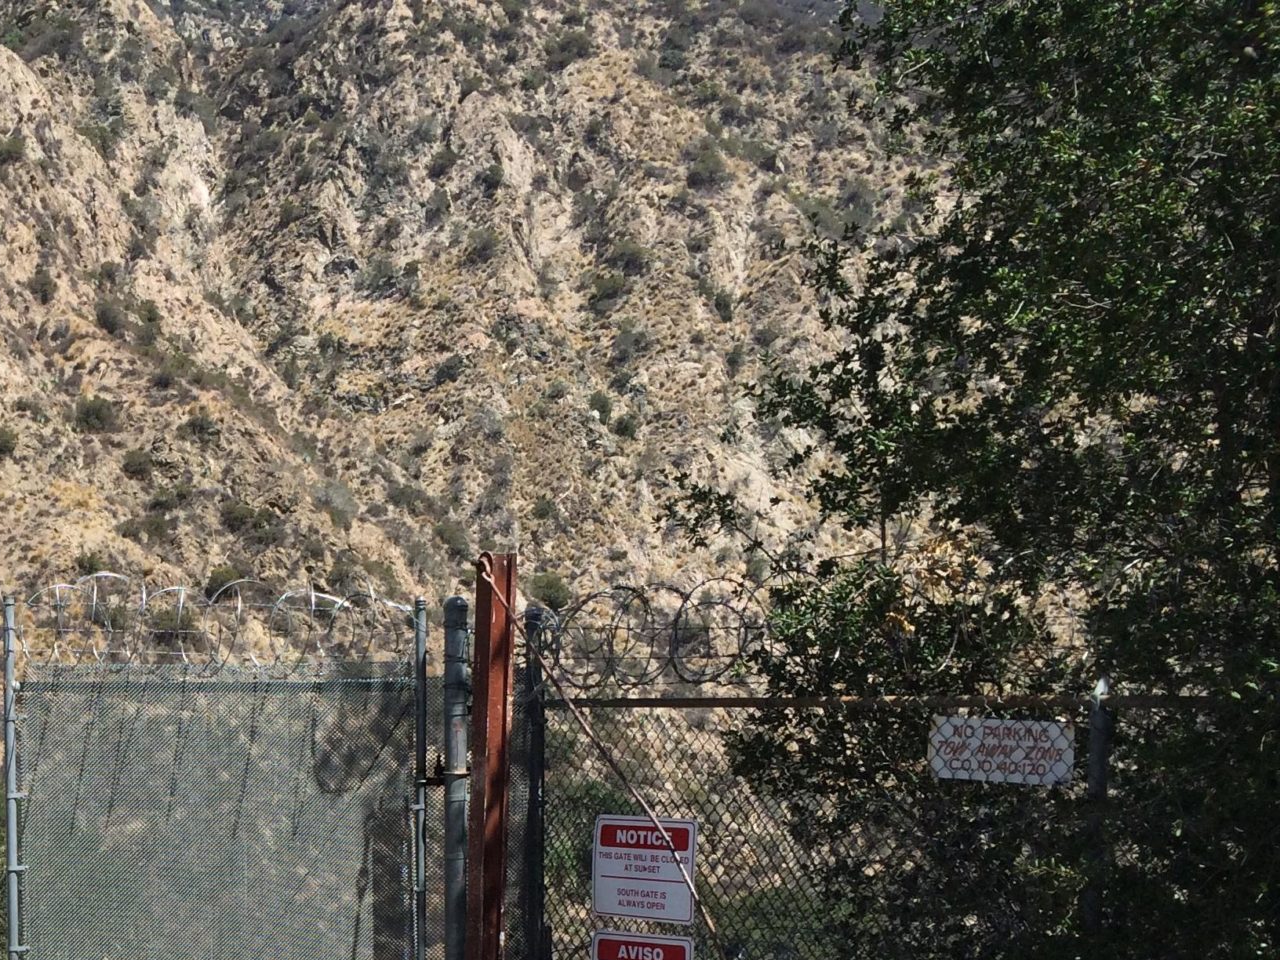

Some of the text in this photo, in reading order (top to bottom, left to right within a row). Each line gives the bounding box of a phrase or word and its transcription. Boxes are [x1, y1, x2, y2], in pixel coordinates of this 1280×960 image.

[953, 725, 1049, 743] NO PARKING
[938, 740, 1063, 761] TOW AWAY ZONE
[661, 856, 689, 864] CLOED
[617, 888, 667, 900] SOUTH GATE IS
[618, 900, 665, 910] ALWAYS OPEN
